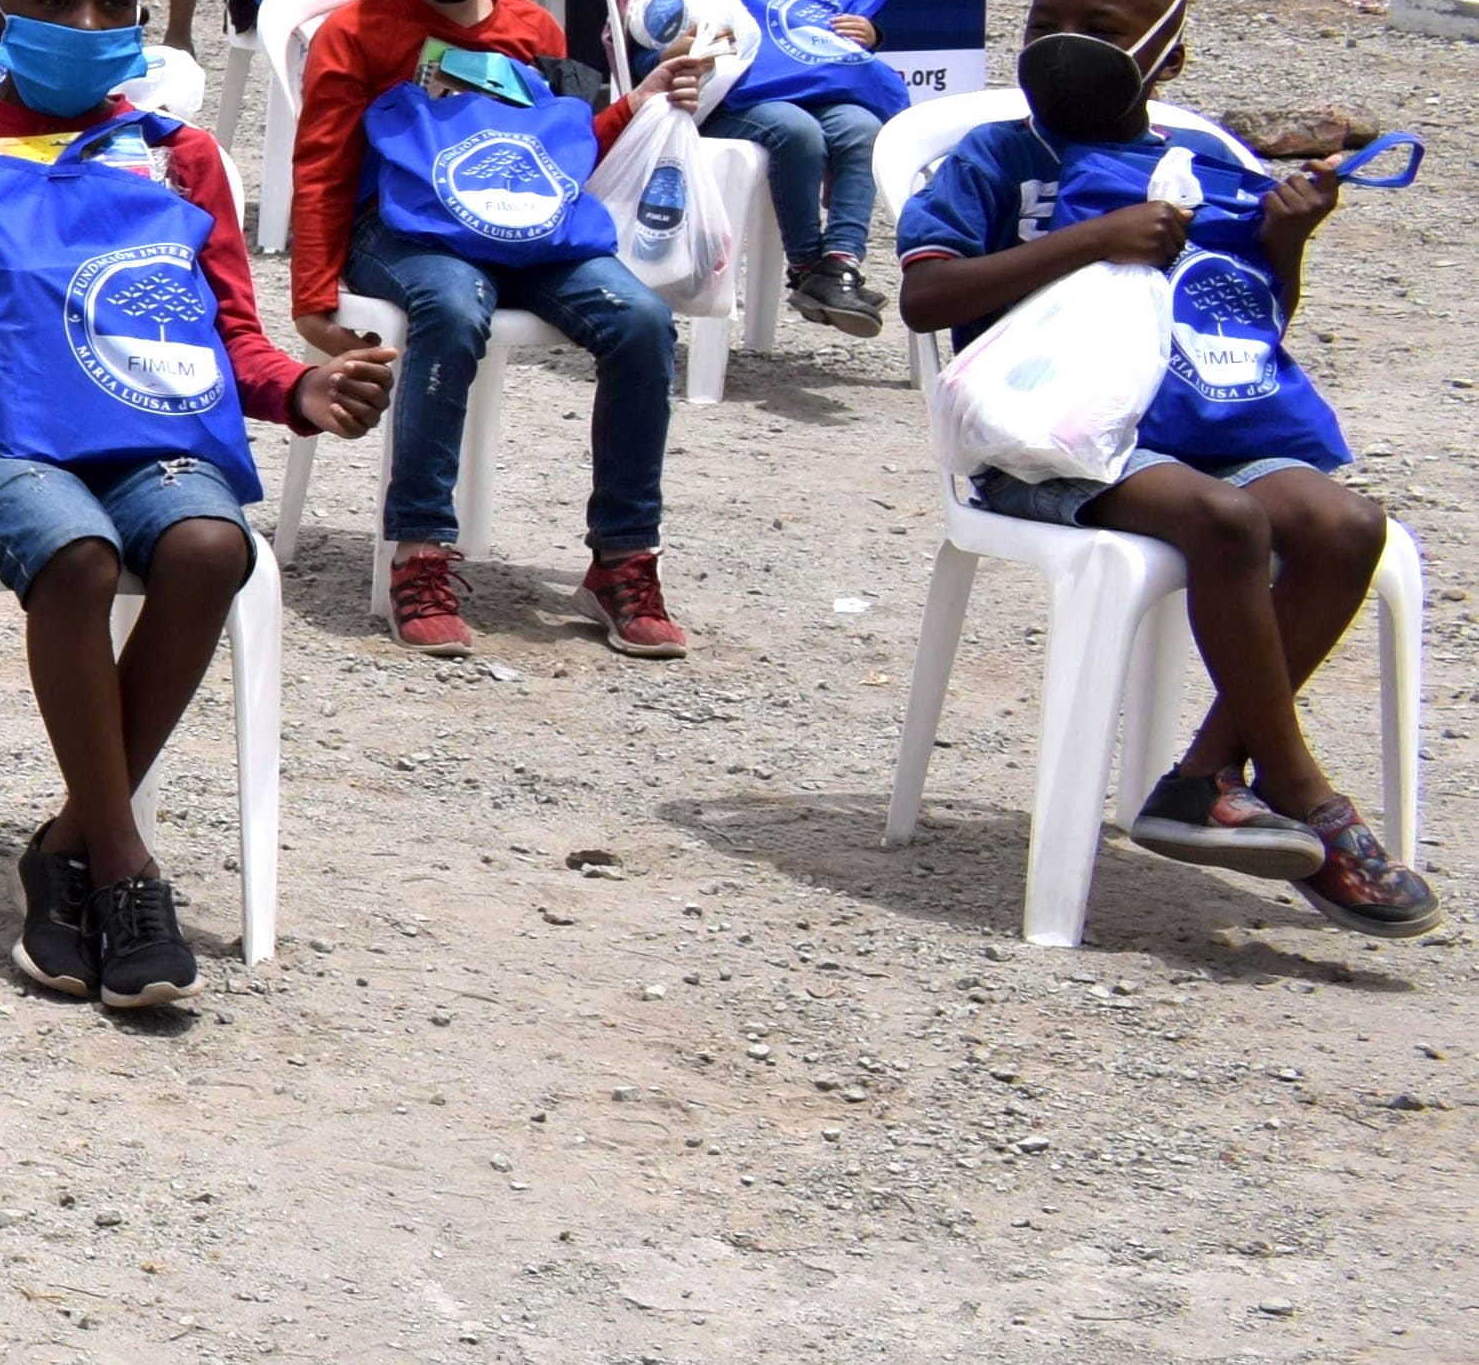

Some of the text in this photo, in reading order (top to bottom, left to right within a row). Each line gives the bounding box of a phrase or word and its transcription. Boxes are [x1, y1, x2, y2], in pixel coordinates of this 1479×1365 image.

[140, 246, 190, 260] INTER
[128, 356, 195, 377] FIMLM
[1170, 354, 1193, 380] RIA
[77, 346, 119, 390] MARIA
[121, 389, 171, 411] LUISA
